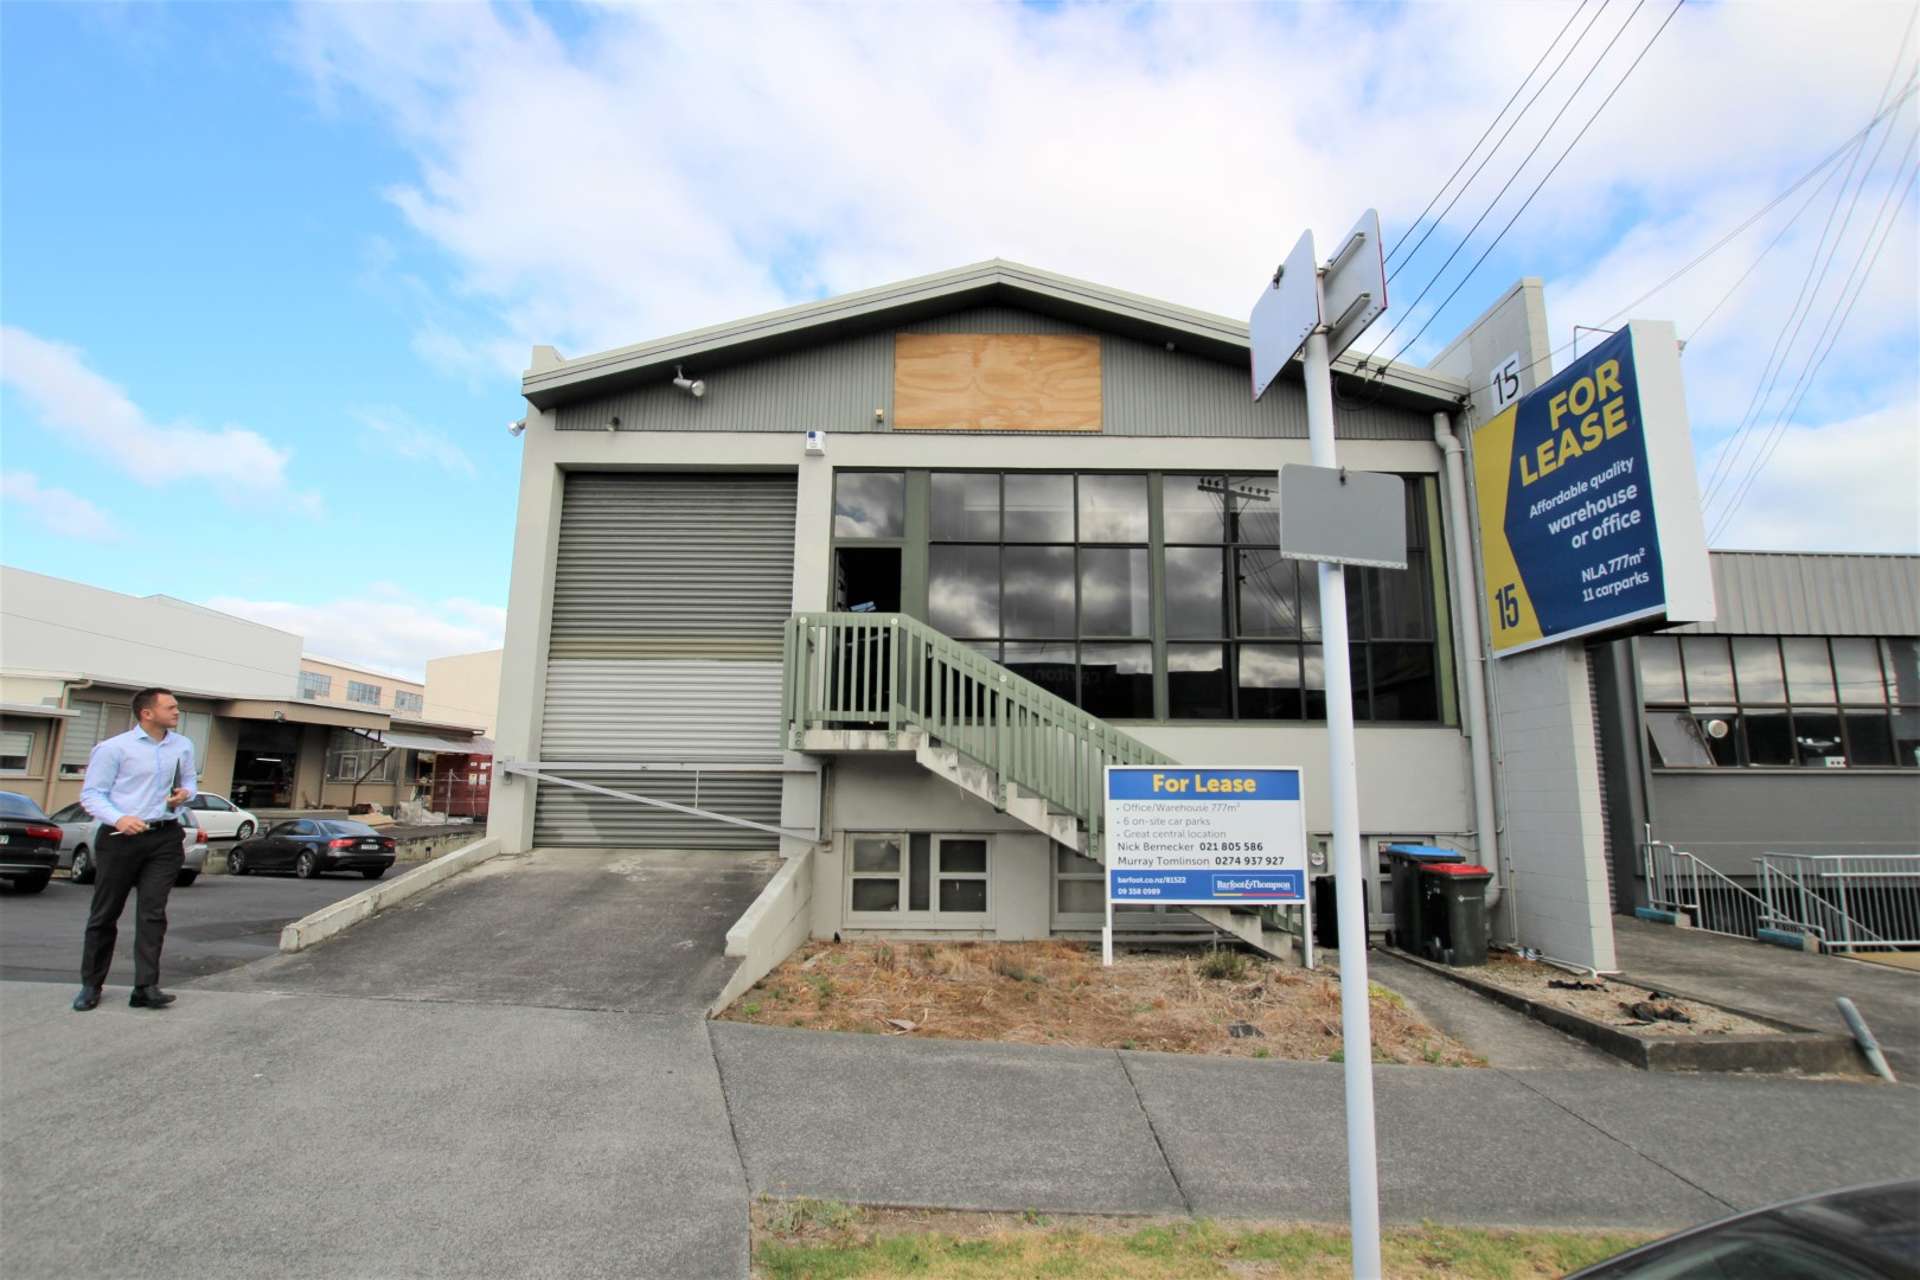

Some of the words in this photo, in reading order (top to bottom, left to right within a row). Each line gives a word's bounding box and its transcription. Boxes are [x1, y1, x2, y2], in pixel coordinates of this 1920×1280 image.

[1493, 360, 1520, 405] 15
[1548, 359, 1623, 431] FOR
[1519, 396, 1629, 488] LEASE
[1529, 481, 1589, 519] Affordable
[1590, 457, 1635, 492] quality
[1548, 483, 1638, 535] warehouse
[1571, 529, 1589, 549] or
[1592, 508, 1642, 541] office
[1581, 562, 1609, 582] NLA
[1582, 588, 1594, 602] 11
[1595, 572, 1650, 600] carparks
[1494, 583, 1520, 630] 15
[1152, 774, 1190, 793] For
[1195, 774, 1257, 793] Lease
[1122, 803, 1209, 813] Office/Warehouse
[1123, 817, 1129, 826] 6
[1131, 817, 1166, 826] on-site
[1168, 818, 1183, 826] car
[1185, 817, 1211, 828] parks
[1123, 830, 1150, 839] Great
[1152, 830, 1186, 839] central
[1187, 830, 1227, 839] location
[1117, 842, 1140, 851] Nick
[1143, 842, 1194, 851] Bernecker
[1199, 842, 1218, 852] 021
[1221, 842, 1241, 852] 805
[1244, 842, 1264, 852] 586
[1118, 857, 1154, 867] Murray
[1156, 856, 1210, 866] Tomlinson
[1215, 856, 1241, 866] 0274
[1244, 856, 1263, 866] 937
[1265, 856, 1285, 866] 927
[1216, 880, 1291, 891] Barfoot&Thompson
